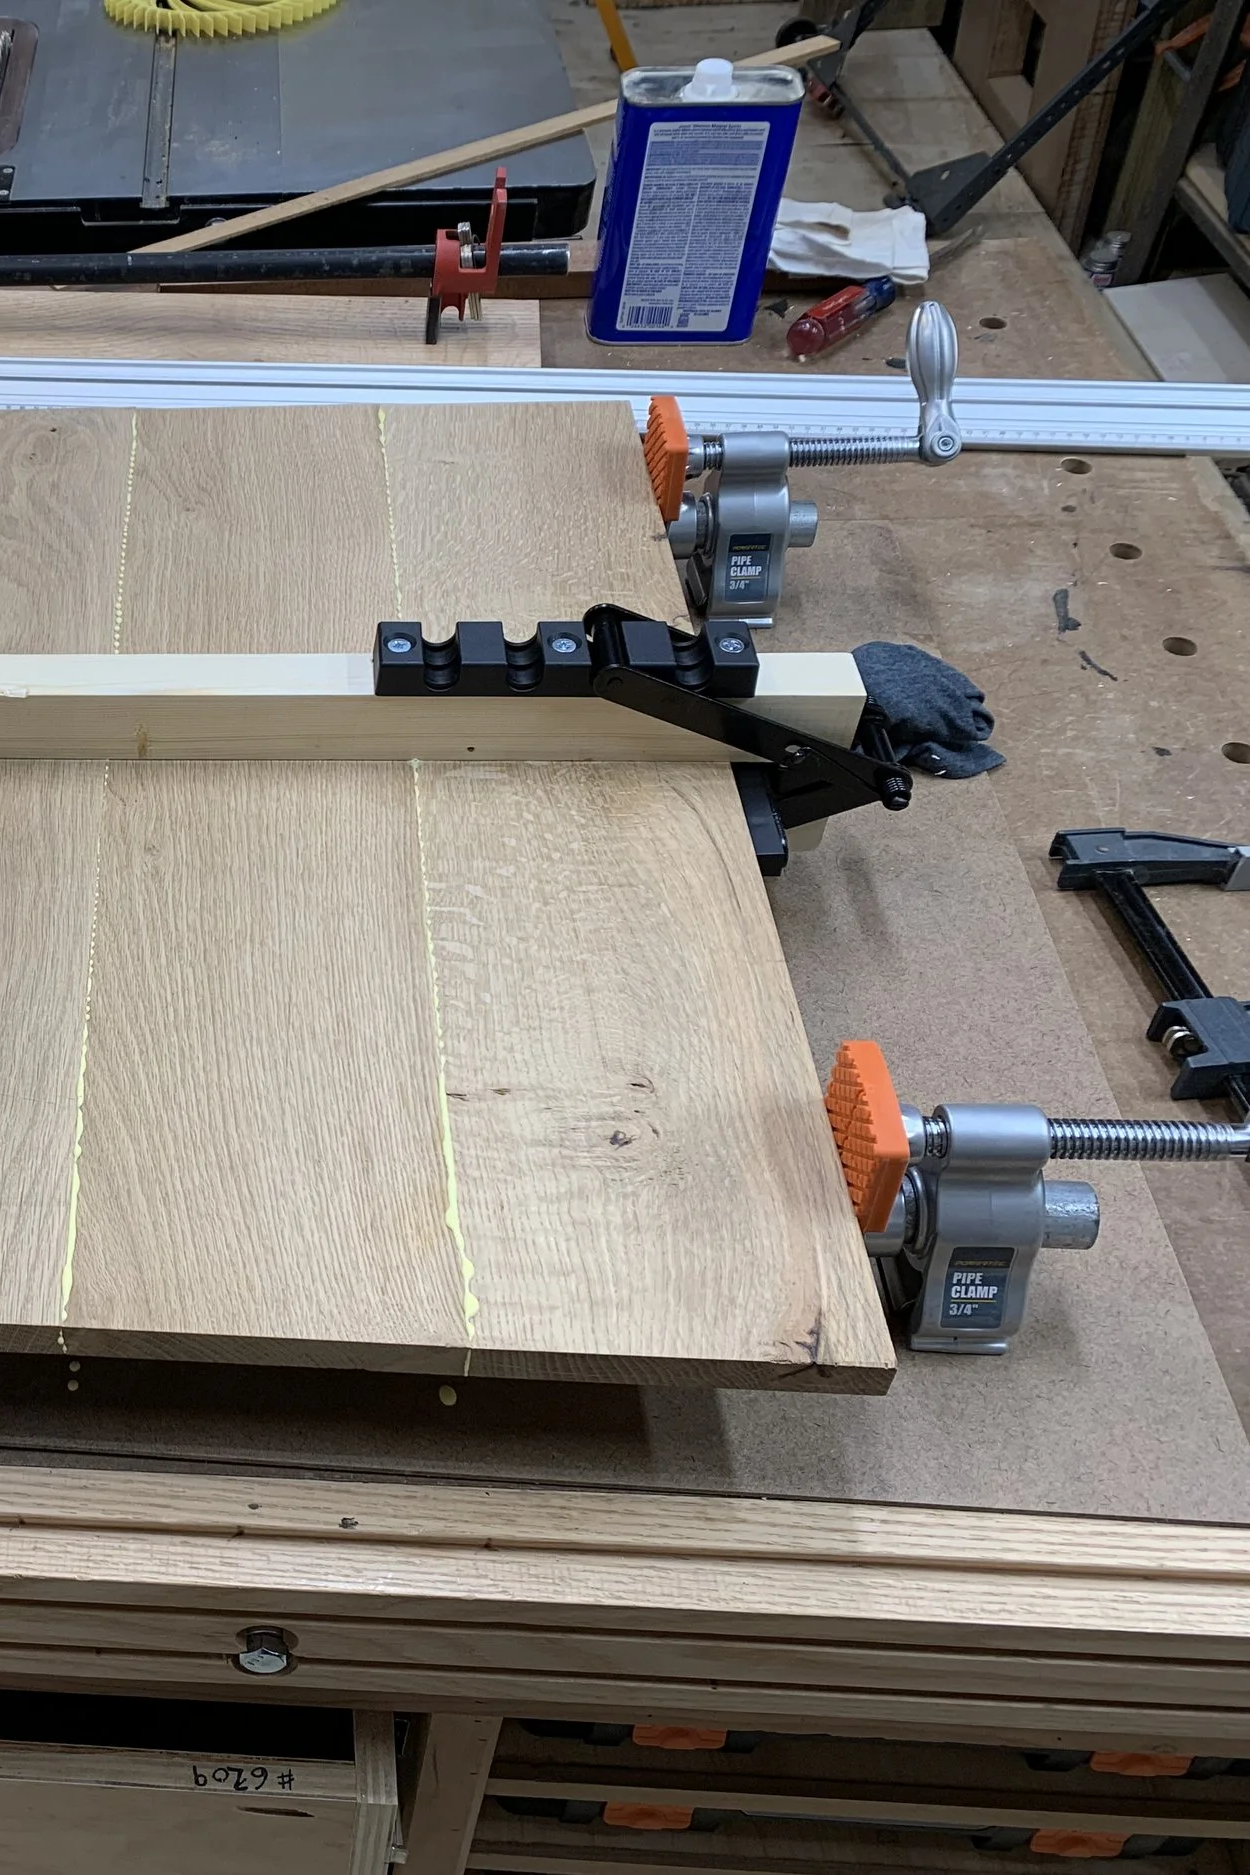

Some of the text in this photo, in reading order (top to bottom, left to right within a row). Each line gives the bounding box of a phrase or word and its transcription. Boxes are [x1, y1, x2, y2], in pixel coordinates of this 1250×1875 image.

[731, 555, 752, 565] PIPE
[730, 566, 762, 576] CLAMP
[729, 580, 749, 590] 3/4"
[952, 1272, 983, 1284] PIPE
[951, 1286, 998, 1298] CLAMP
[949, 1304, 978, 1316] 3/4"
